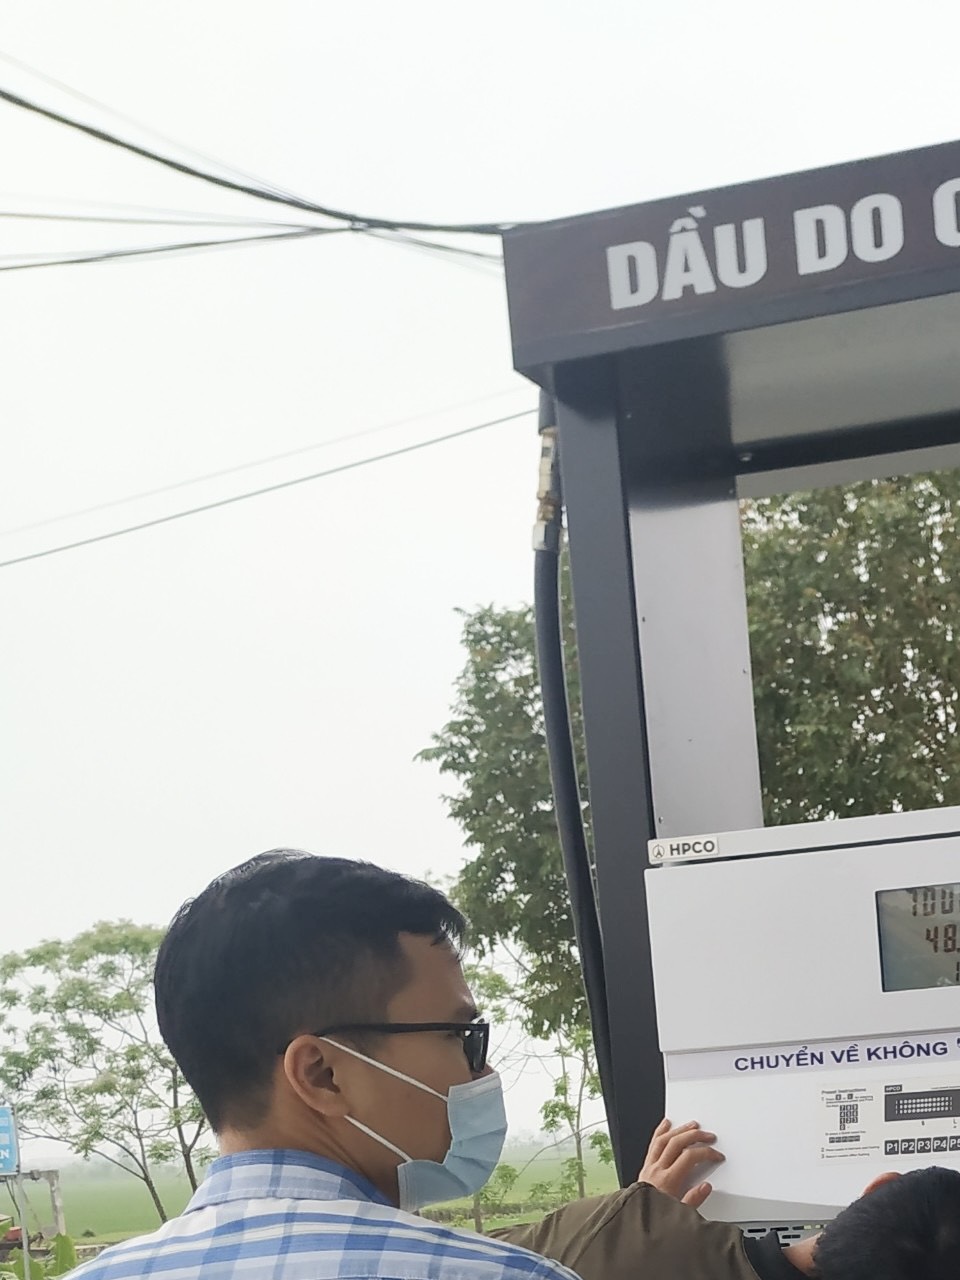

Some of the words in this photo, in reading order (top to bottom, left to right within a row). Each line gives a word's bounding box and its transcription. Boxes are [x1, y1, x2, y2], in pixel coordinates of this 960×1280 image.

[606, 205, 767, 310] DẦU
[793, 193, 904, 275] DO
[670, 840, 715, 856] HPCO
[734, 1045, 824, 1071] CHUYỂN
[831, 1043, 859, 1064] VỀ
[866, 1041, 948, 1061] KHÔNG
[886, 1142, 898, 1152] P1
[902, 1142, 914, 1151] P2
[917, 1140, 930, 1150] P3
[933, 1139, 947, 1149] P4
